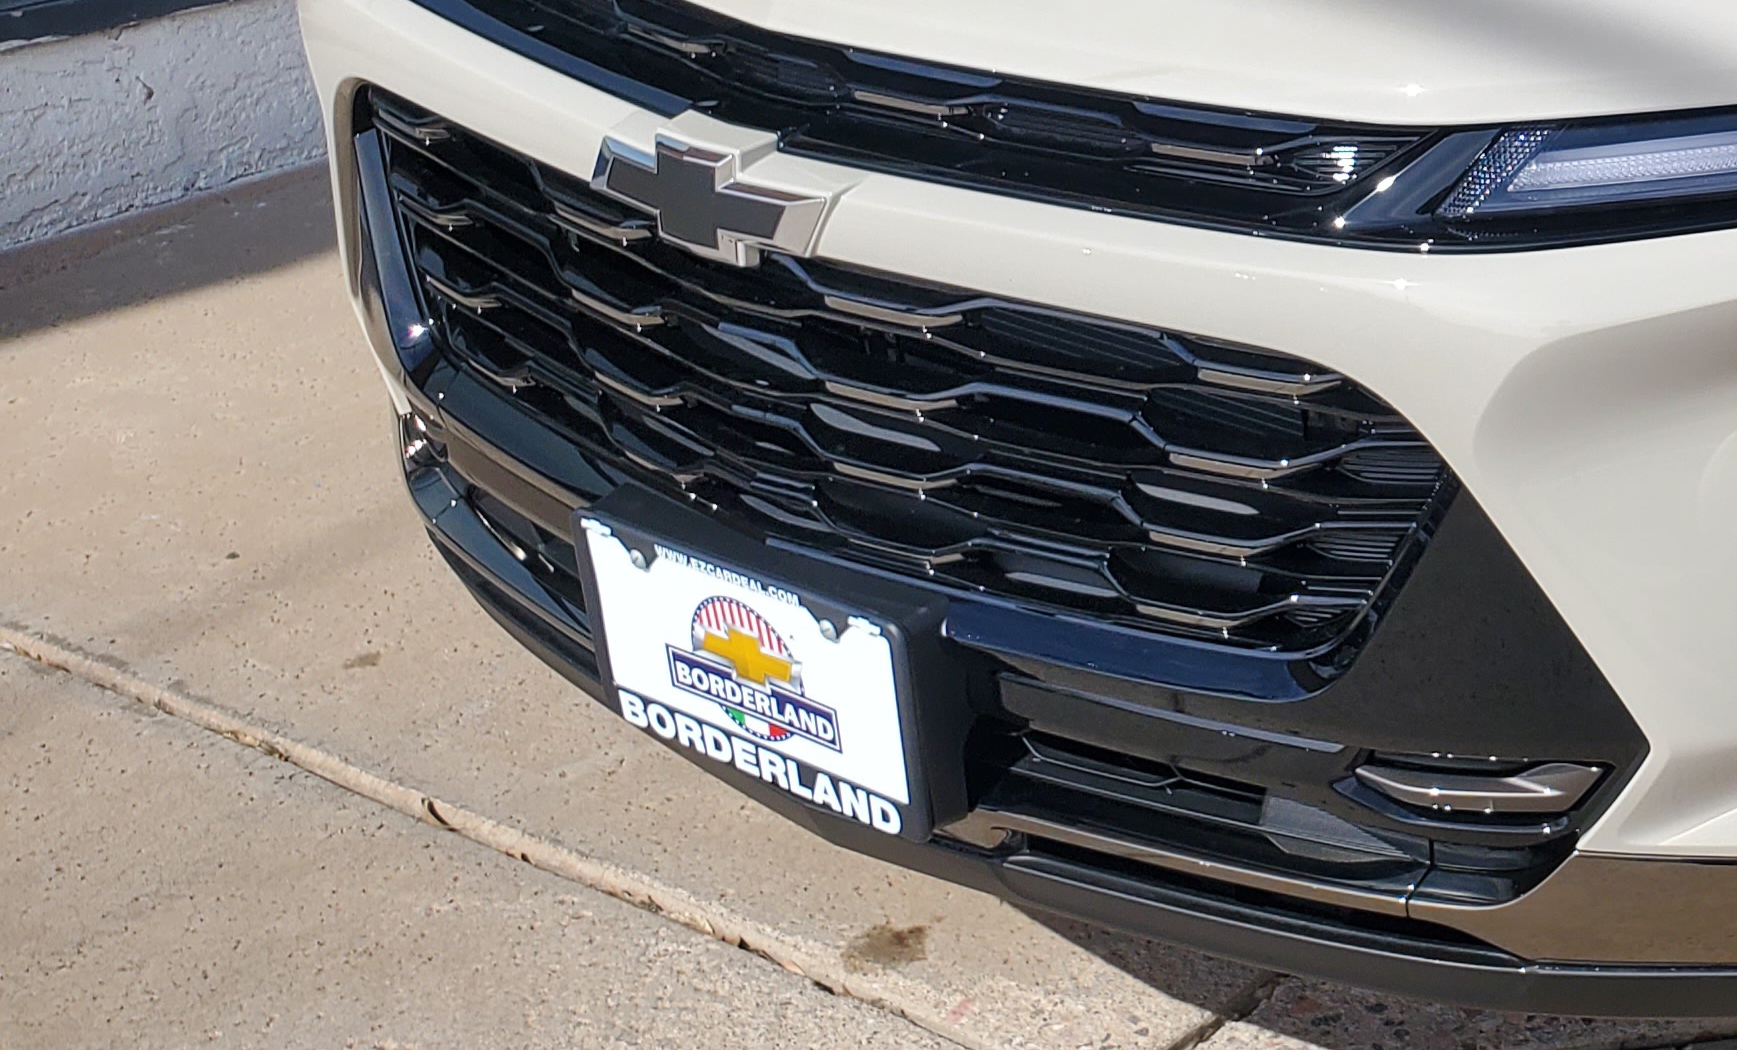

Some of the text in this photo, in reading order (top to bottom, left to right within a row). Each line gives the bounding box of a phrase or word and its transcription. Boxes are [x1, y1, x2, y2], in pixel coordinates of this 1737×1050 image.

[653, 543, 801, 607] WWW.EZCARDEAL.COM
[675, 661, 835, 741] BORDERLAND
[617, 689, 903, 836] BORDERLAND
